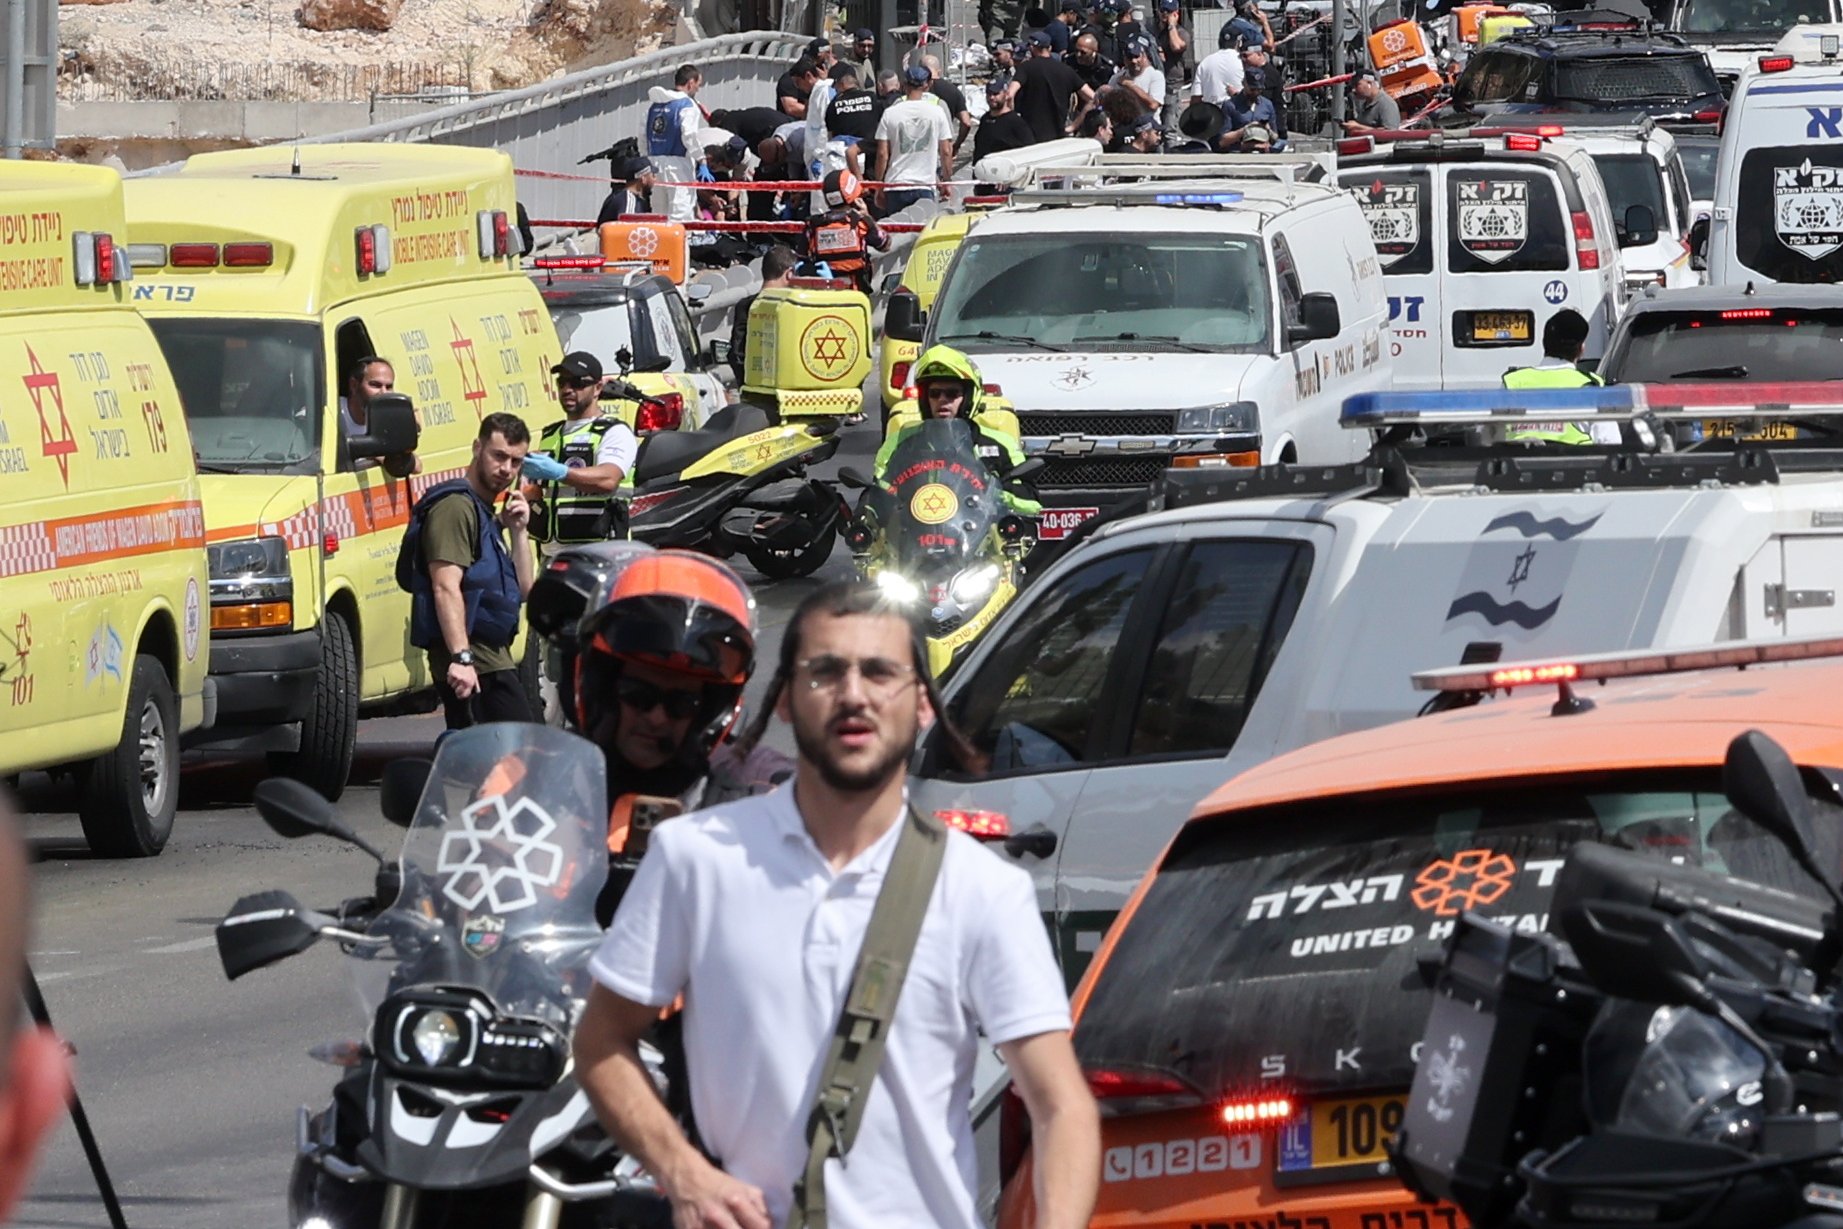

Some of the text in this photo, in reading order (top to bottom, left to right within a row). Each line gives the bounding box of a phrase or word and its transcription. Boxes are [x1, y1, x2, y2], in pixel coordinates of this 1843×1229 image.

[836, 103, 873, 115] POLICE
[391, 187, 468, 232] ניידת טיפול נמרץ
[32, 212, 62, 244] ניידת
[27, 259, 45, 286] CARE
[46, 256, 64, 286] UNIT
[130, 284, 196, 303] פרא
[1545, 283, 1566, 300] 44
[400, 329, 430, 353] MAGEN
[898, 346, 918, 356] 64
[69, 351, 111, 385] מגן דוד
[409, 353, 434, 377] DAVID
[500, 348, 523, 374] אדום
[93, 389, 122, 420] אדום
[417, 378, 441, 402] ADOM
[497, 380, 530, 411] בישראל
[141, 400, 168, 454] 179
[433, 401, 456, 425] ISRAEL
[88, 425, 131, 460] בישראל
[12, 673, 33, 707] 101
[1247, 873, 1405, 921] הצלה
[1290, 923, 1413, 958] UNITED
[1330, 1103, 1405, 1157] 109
[1141, 1138, 1256, 1171] 1221
